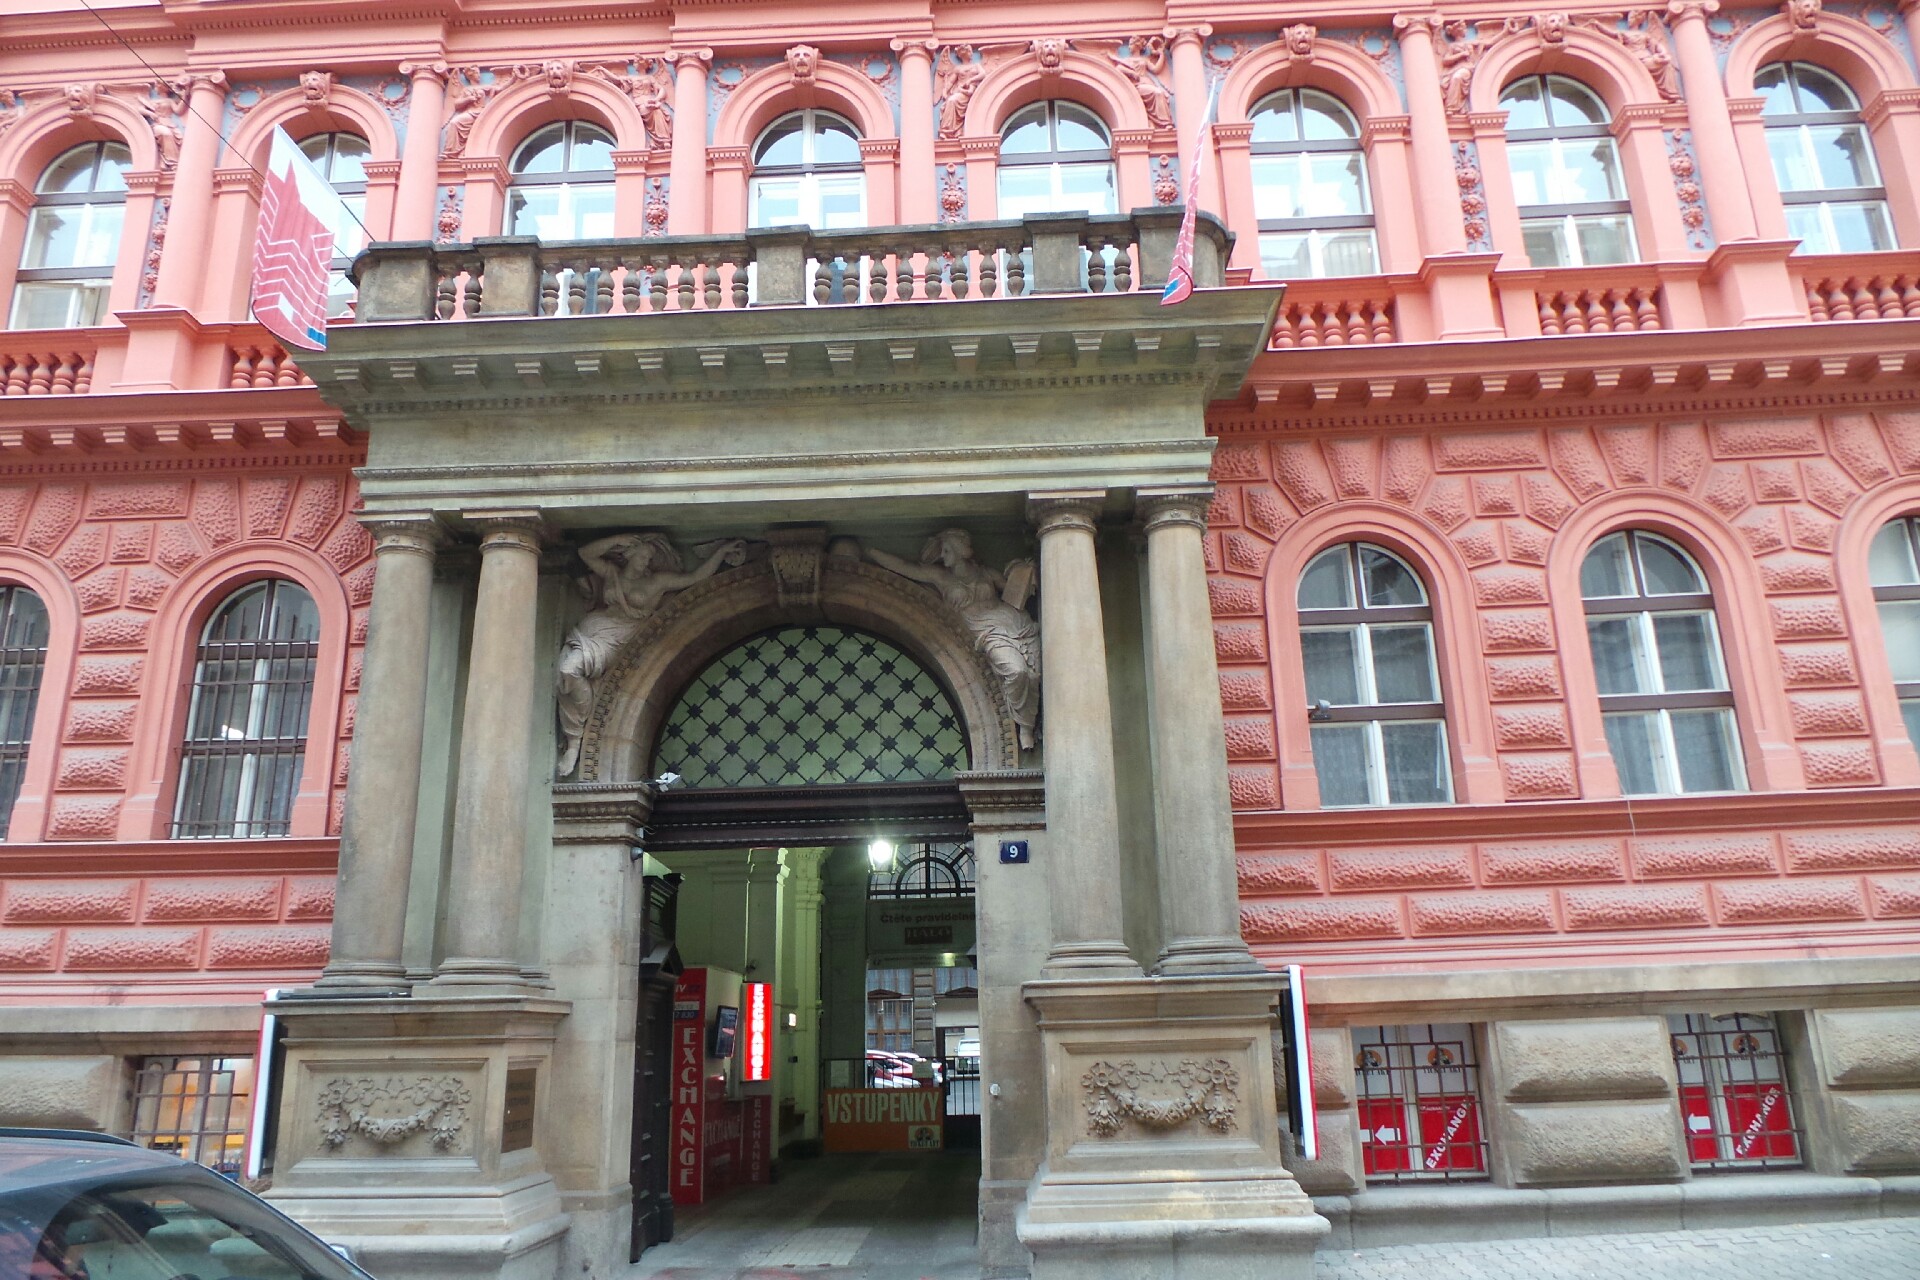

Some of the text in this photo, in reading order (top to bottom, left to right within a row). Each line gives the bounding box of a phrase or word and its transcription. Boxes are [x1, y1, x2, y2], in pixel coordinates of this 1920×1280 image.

[1010, 845, 1018, 858] 9
[751, 984, 764, 1080] EXCHANGE
[679, 1027, 698, 1186] EXCHANGE
[752, 1098, 761, 1181] EXCHANGE
[827, 1092, 939, 1124] VSTUPENKY
